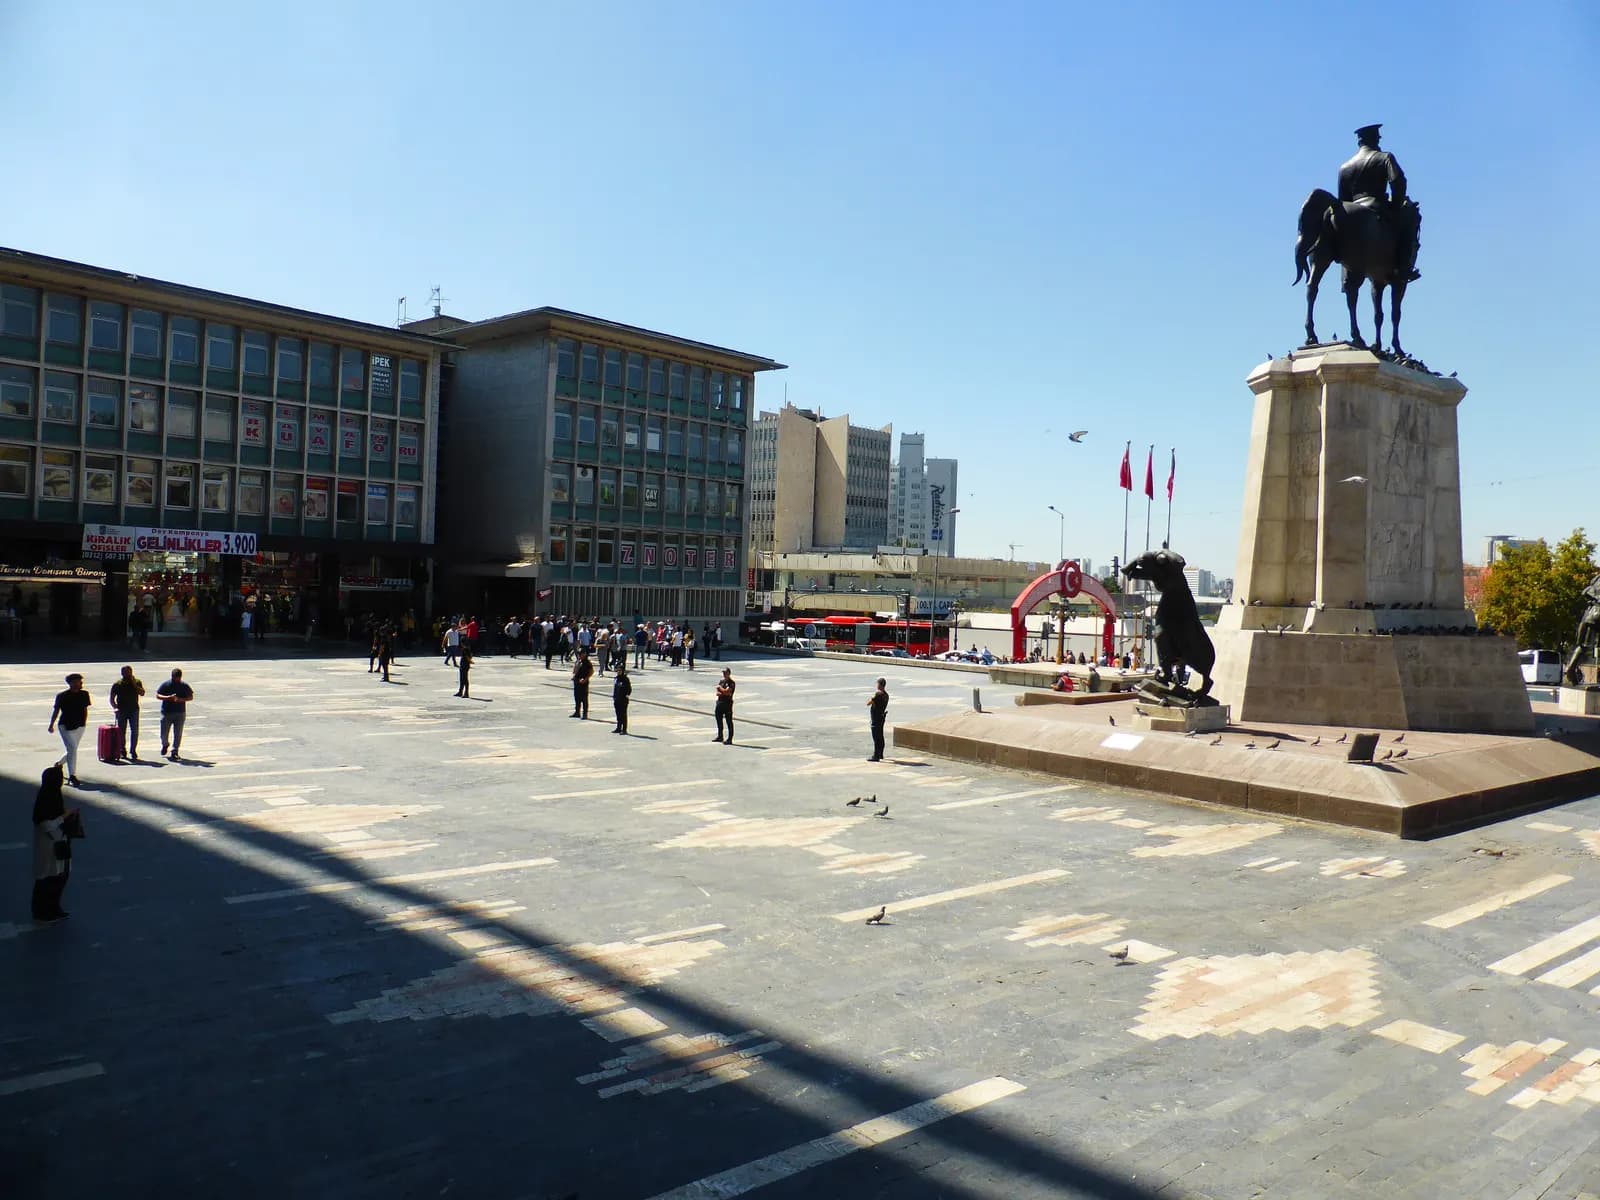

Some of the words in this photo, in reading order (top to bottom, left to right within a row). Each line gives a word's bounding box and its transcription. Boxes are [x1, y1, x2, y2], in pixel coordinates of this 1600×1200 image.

[86, 535, 131, 545] KİRALIK
[136, 535, 221, 553] GELİNLİKLER
[223, 534, 255, 553] 3.900
